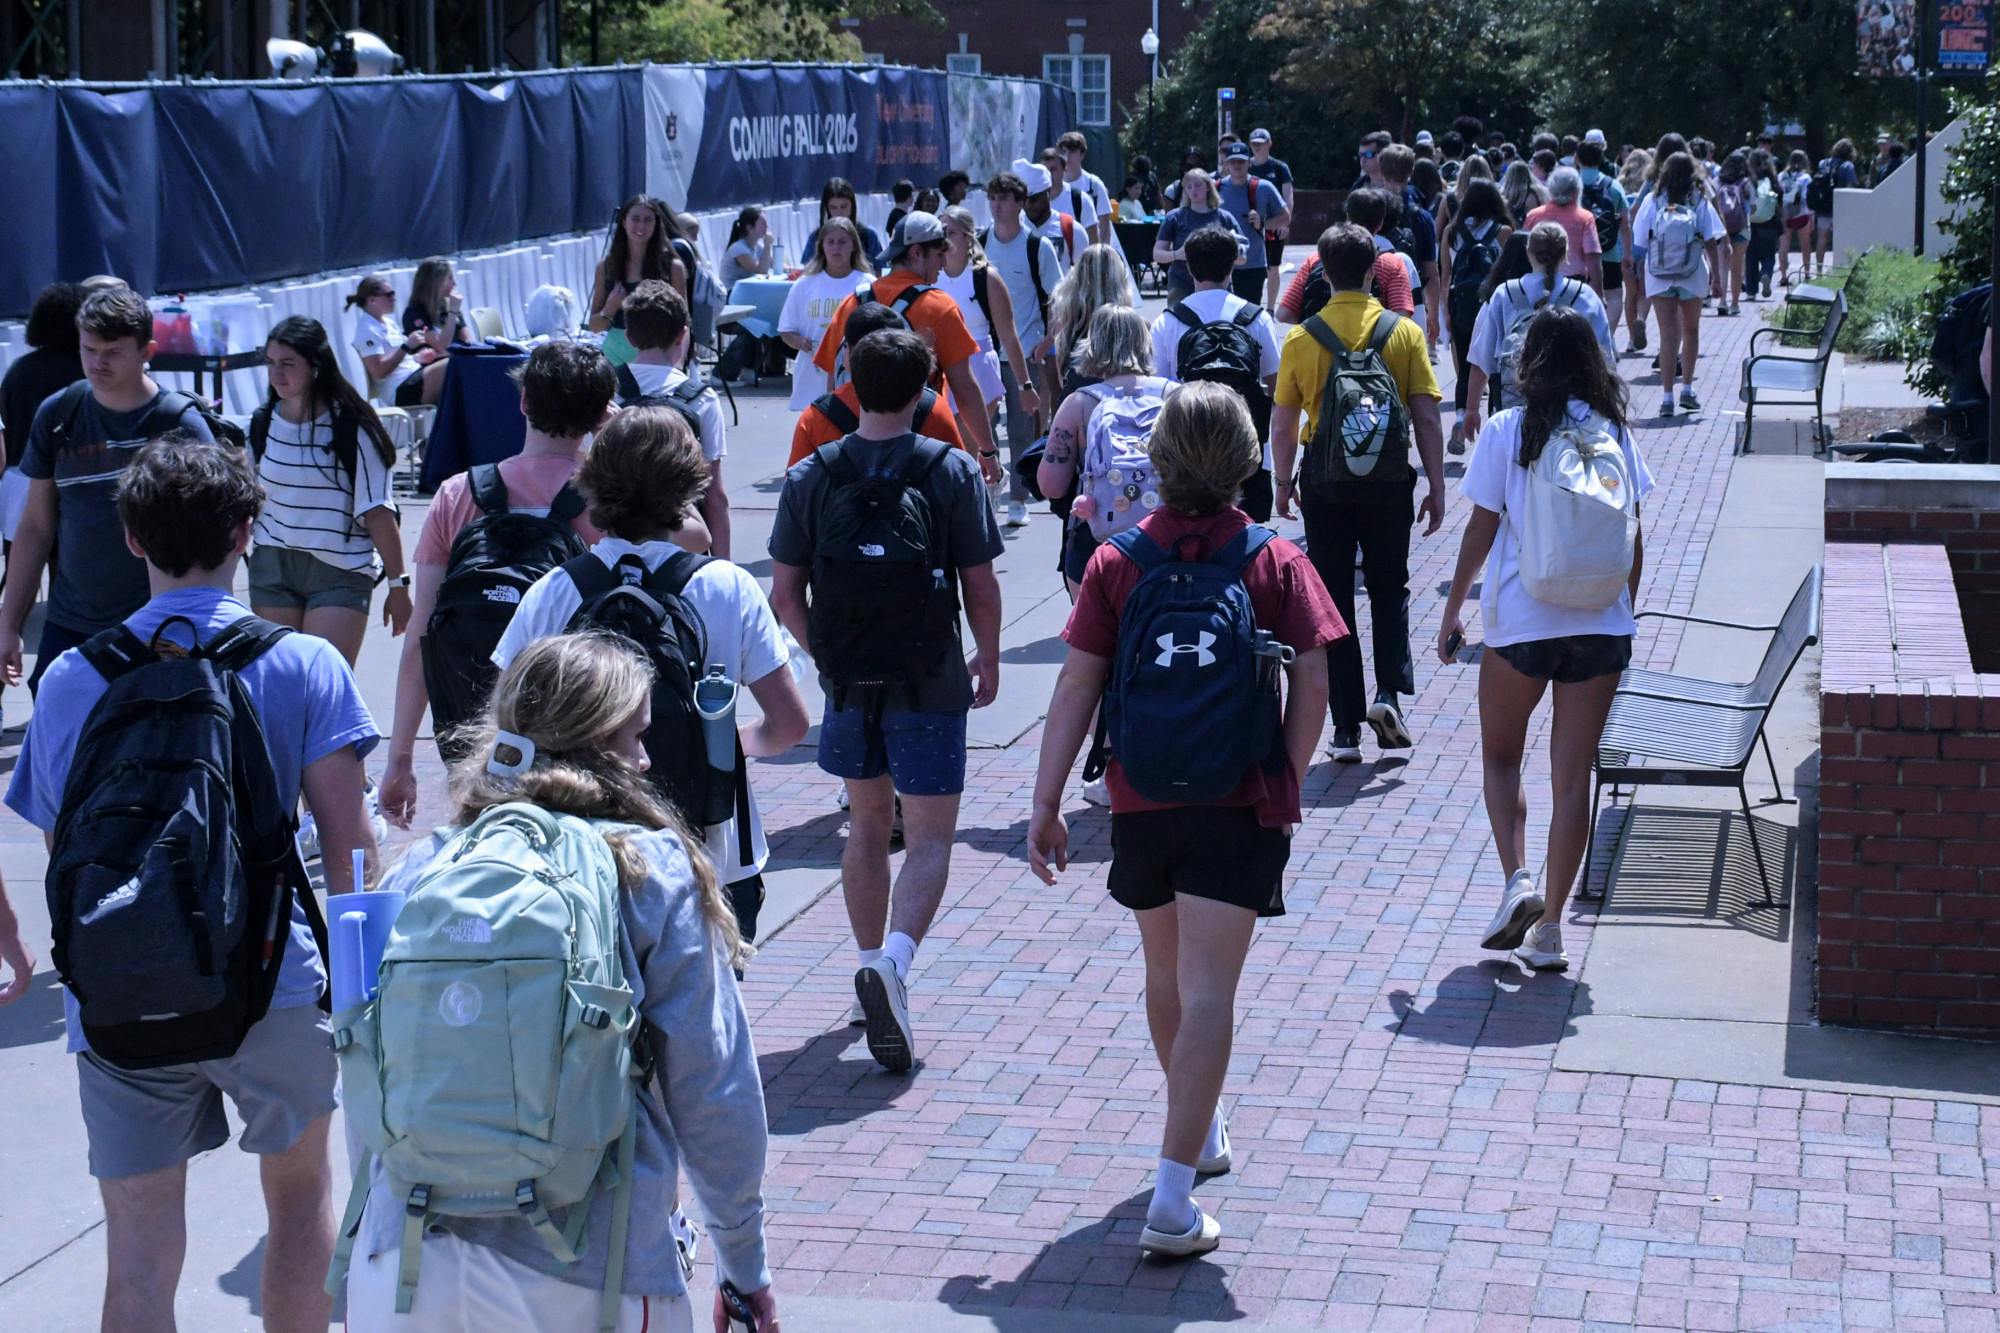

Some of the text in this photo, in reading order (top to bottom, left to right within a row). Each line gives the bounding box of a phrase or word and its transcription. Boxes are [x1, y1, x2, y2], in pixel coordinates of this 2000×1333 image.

[729, 115, 792, 162] COMING
[794, 113, 824, 156] FALL
[457, 918, 477, 927] THE
[441, 926, 480, 937] NORTH
[449, 934, 474, 944] FACE
